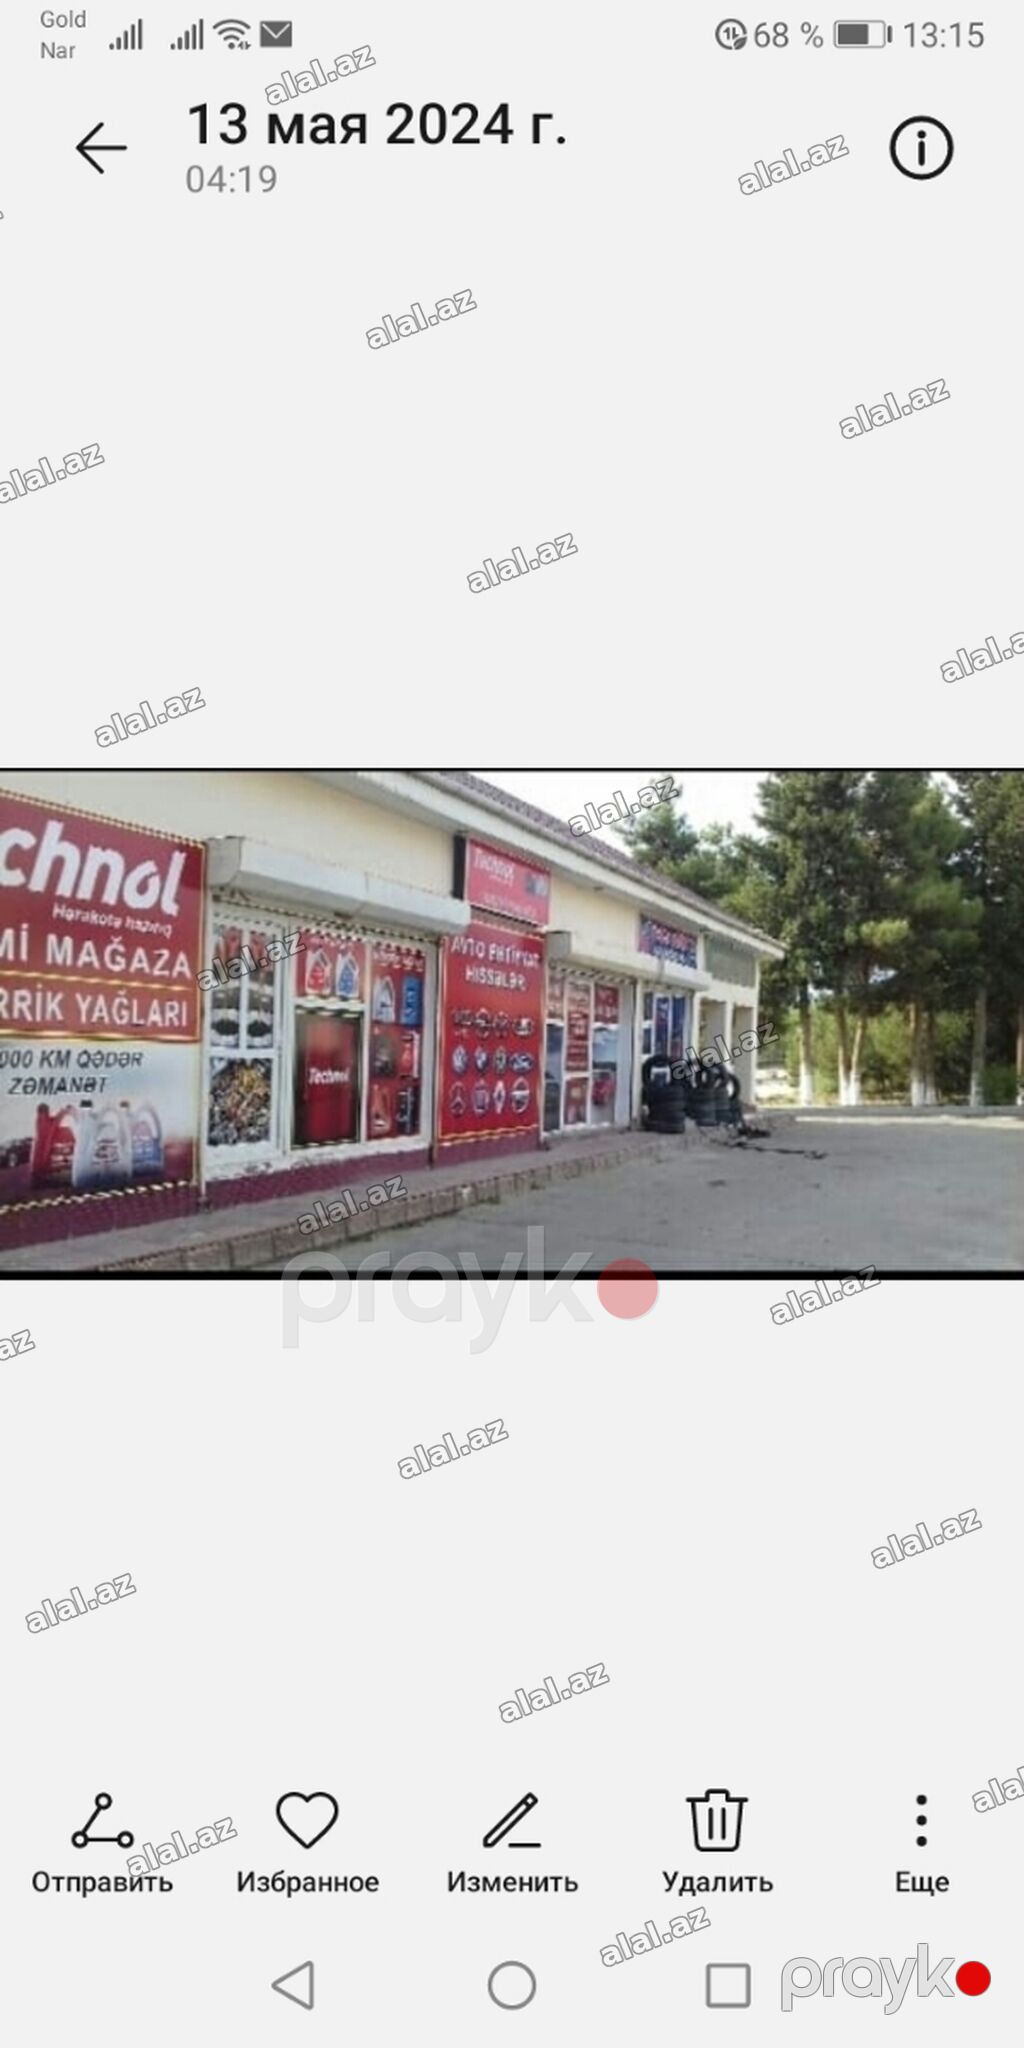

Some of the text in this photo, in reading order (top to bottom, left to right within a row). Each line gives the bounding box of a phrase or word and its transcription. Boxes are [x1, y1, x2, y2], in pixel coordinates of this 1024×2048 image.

[40, 10, 86, 28] Gold
[753, 21, 824, 48] 68 %
[904, 21, 985, 48] 13:15
[40, 41, 76, 59] Nar
[189, 102, 566, 145] 13 мая 2024 г.
[186, 164, 277, 194] 04:19
[46, 932, 192, 981] MAĞAZA
[76, 988, 188, 1028] YAĞLARI
[39, 1049, 71, 1069] KM
[77, 1048, 144, 1069] QƏDƏR
[32, 1870, 174, 1899] Отправить
[237, 1869, 380, 1897] Избранное
[447, 1870, 579, 1895] Изменить
[662, 1870, 774, 1897] Удалить
[896, 1870, 950, 1897] Еще
